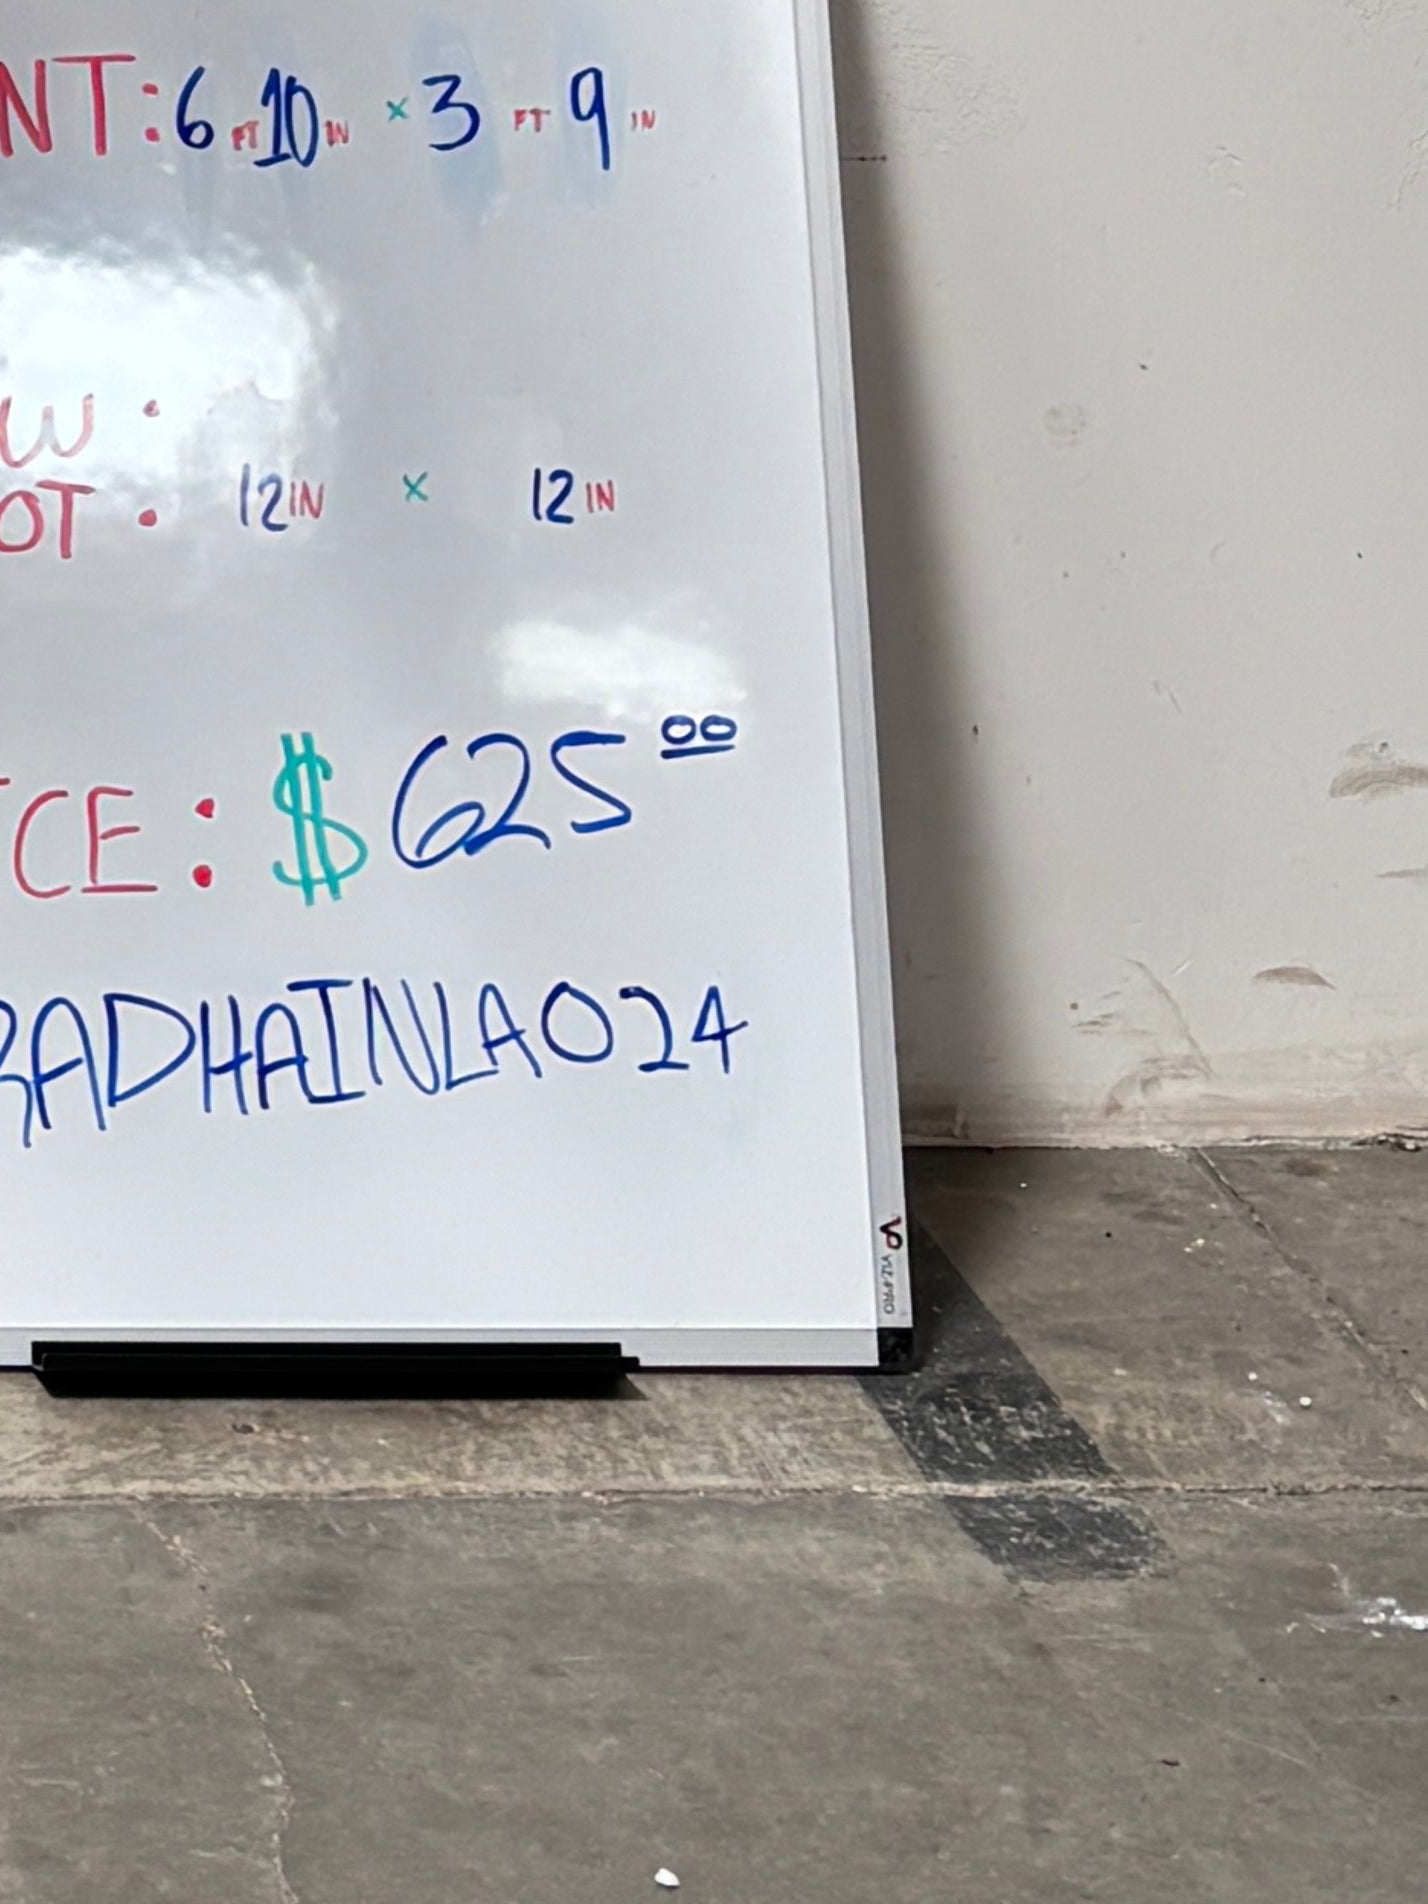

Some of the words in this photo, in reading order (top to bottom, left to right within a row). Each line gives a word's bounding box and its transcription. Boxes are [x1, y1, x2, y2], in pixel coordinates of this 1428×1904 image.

[175, 65, 214, 153] 6
[254, 64, 317, 170] 10
[424, 73, 481, 151] 3
[569, 67, 611, 170] 9
